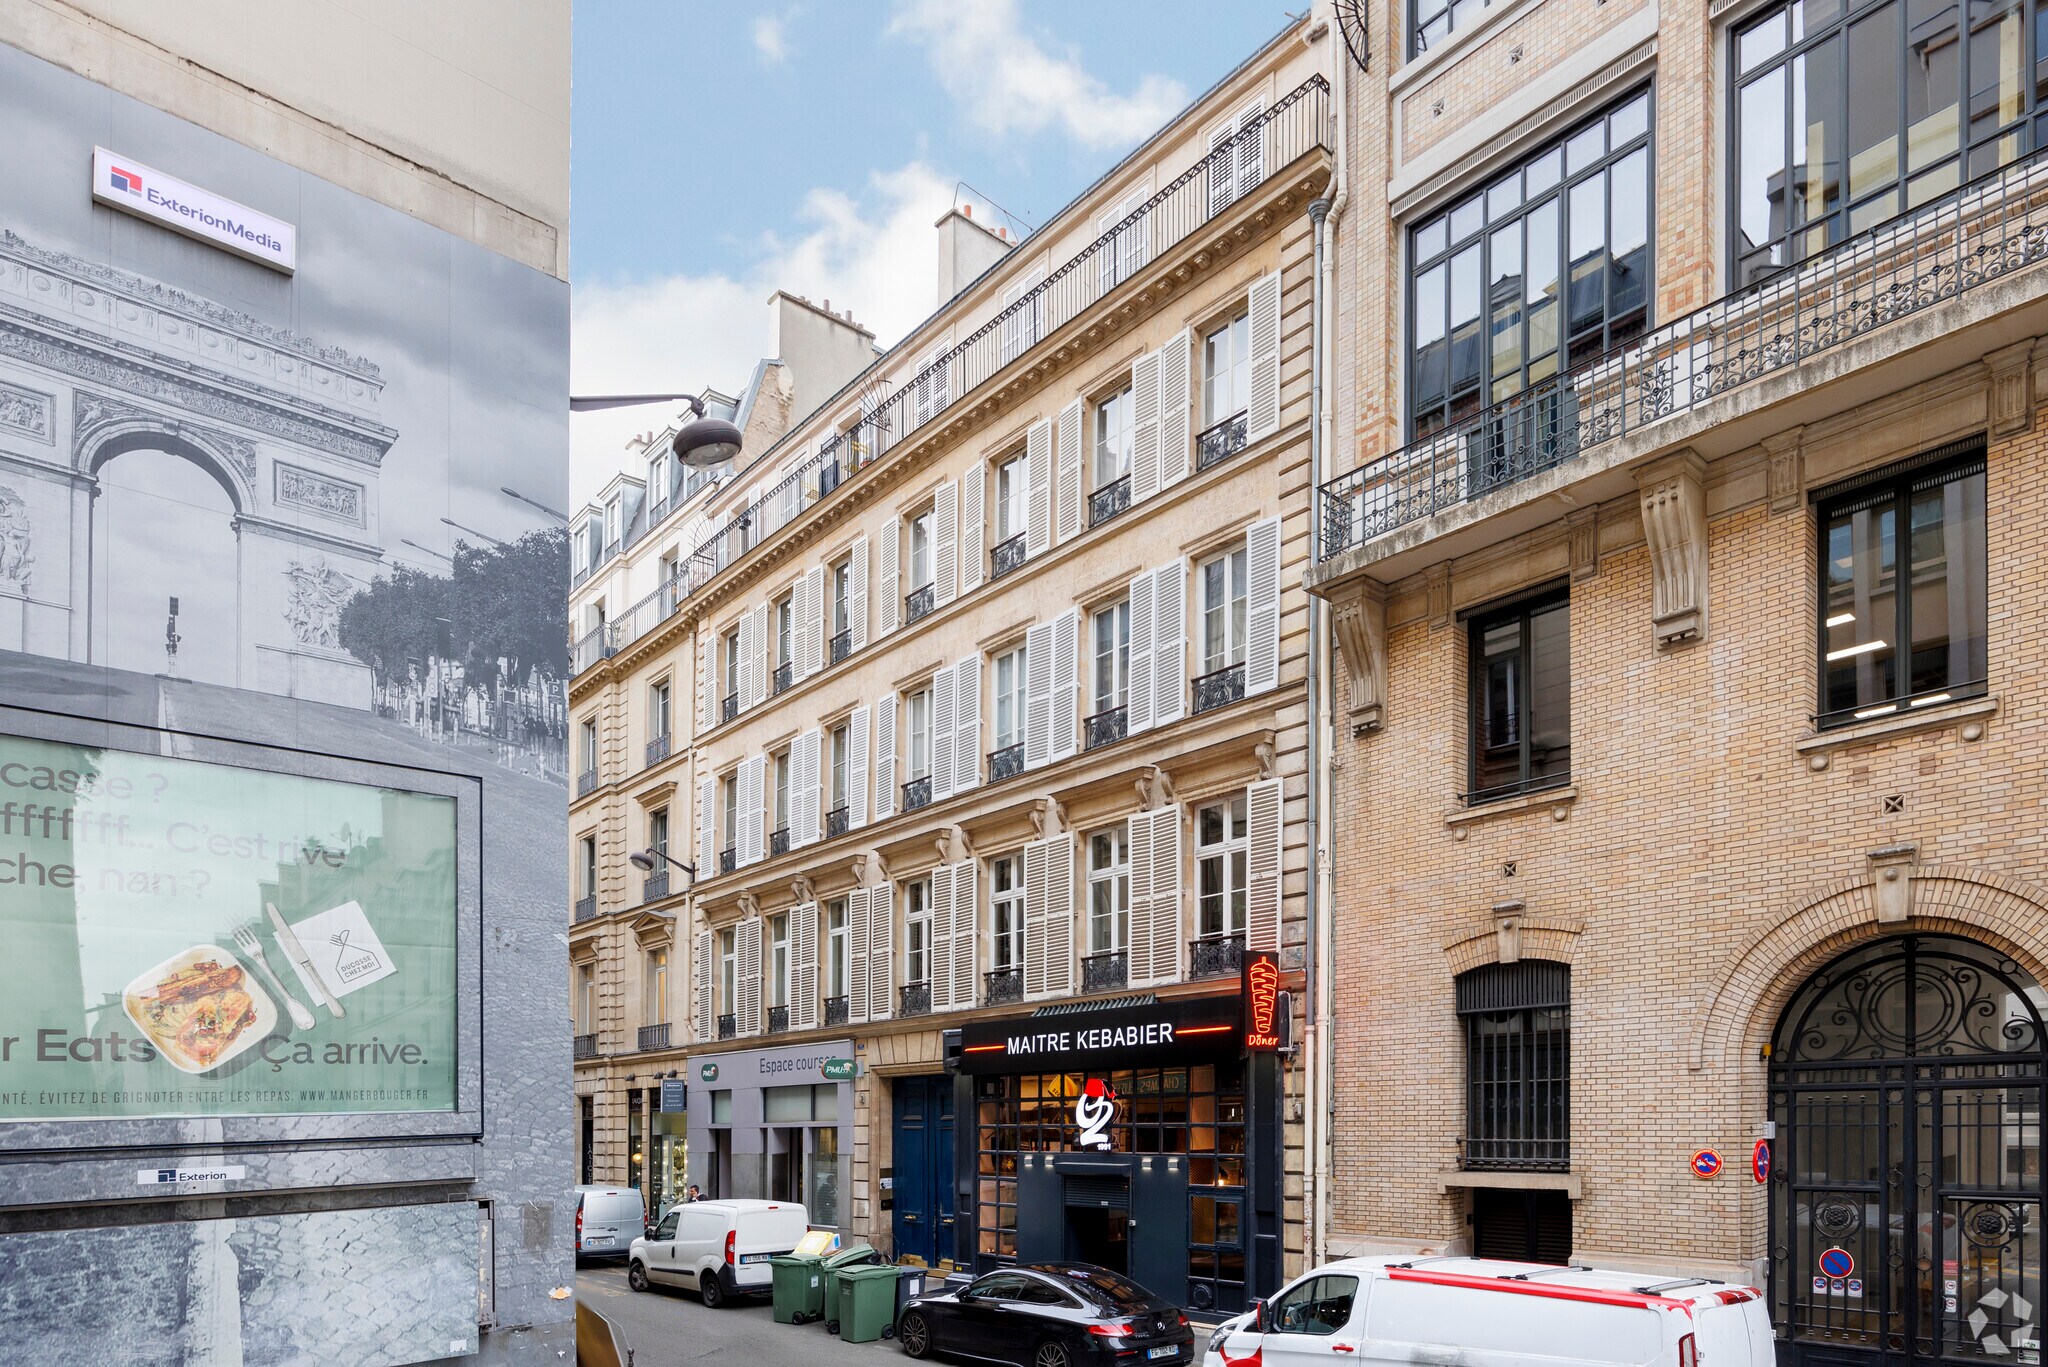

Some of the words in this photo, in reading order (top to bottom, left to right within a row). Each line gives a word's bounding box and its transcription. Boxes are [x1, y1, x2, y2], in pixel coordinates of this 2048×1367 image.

[147, 187, 281, 252] ExterionMedia
[0, 763, 134, 800] casse
[146, 772, 169, 803] ?
[278, 834, 346, 868] rive
[340, 955, 372, 972] DUCOSSE
[344, 965, 362, 978] CHEZ
[361, 961, 376, 971] MOI
[36, 1028, 157, 1063] Eats
[1007, 1032, 1070, 1055] MAITRE
[1076, 1022, 1174, 1050] KEBABIER
[1248, 1034, 1279, 1046] Döner
[258, 1034, 315, 1073] Ça
[322, 1036, 428, 1065] arrive.
[759, 1057, 793, 1077] Espace
[825, 1065, 843, 1074] PMU
[39, 1089, 85, 1105] ÉVITEZ
[92, 1091, 107, 1104] DE
[113, 1091, 184, 1104] GRIGNOTER
[188, 1090, 224, 1103] ENTRE
[230, 1090, 250, 1103] LES
[256, 1090, 295, 1102] REPAS.
[299, 1089, 428, 1102] WWW.MANGERBOUGER.FR
[179, 1171, 227, 1182] Exterion
